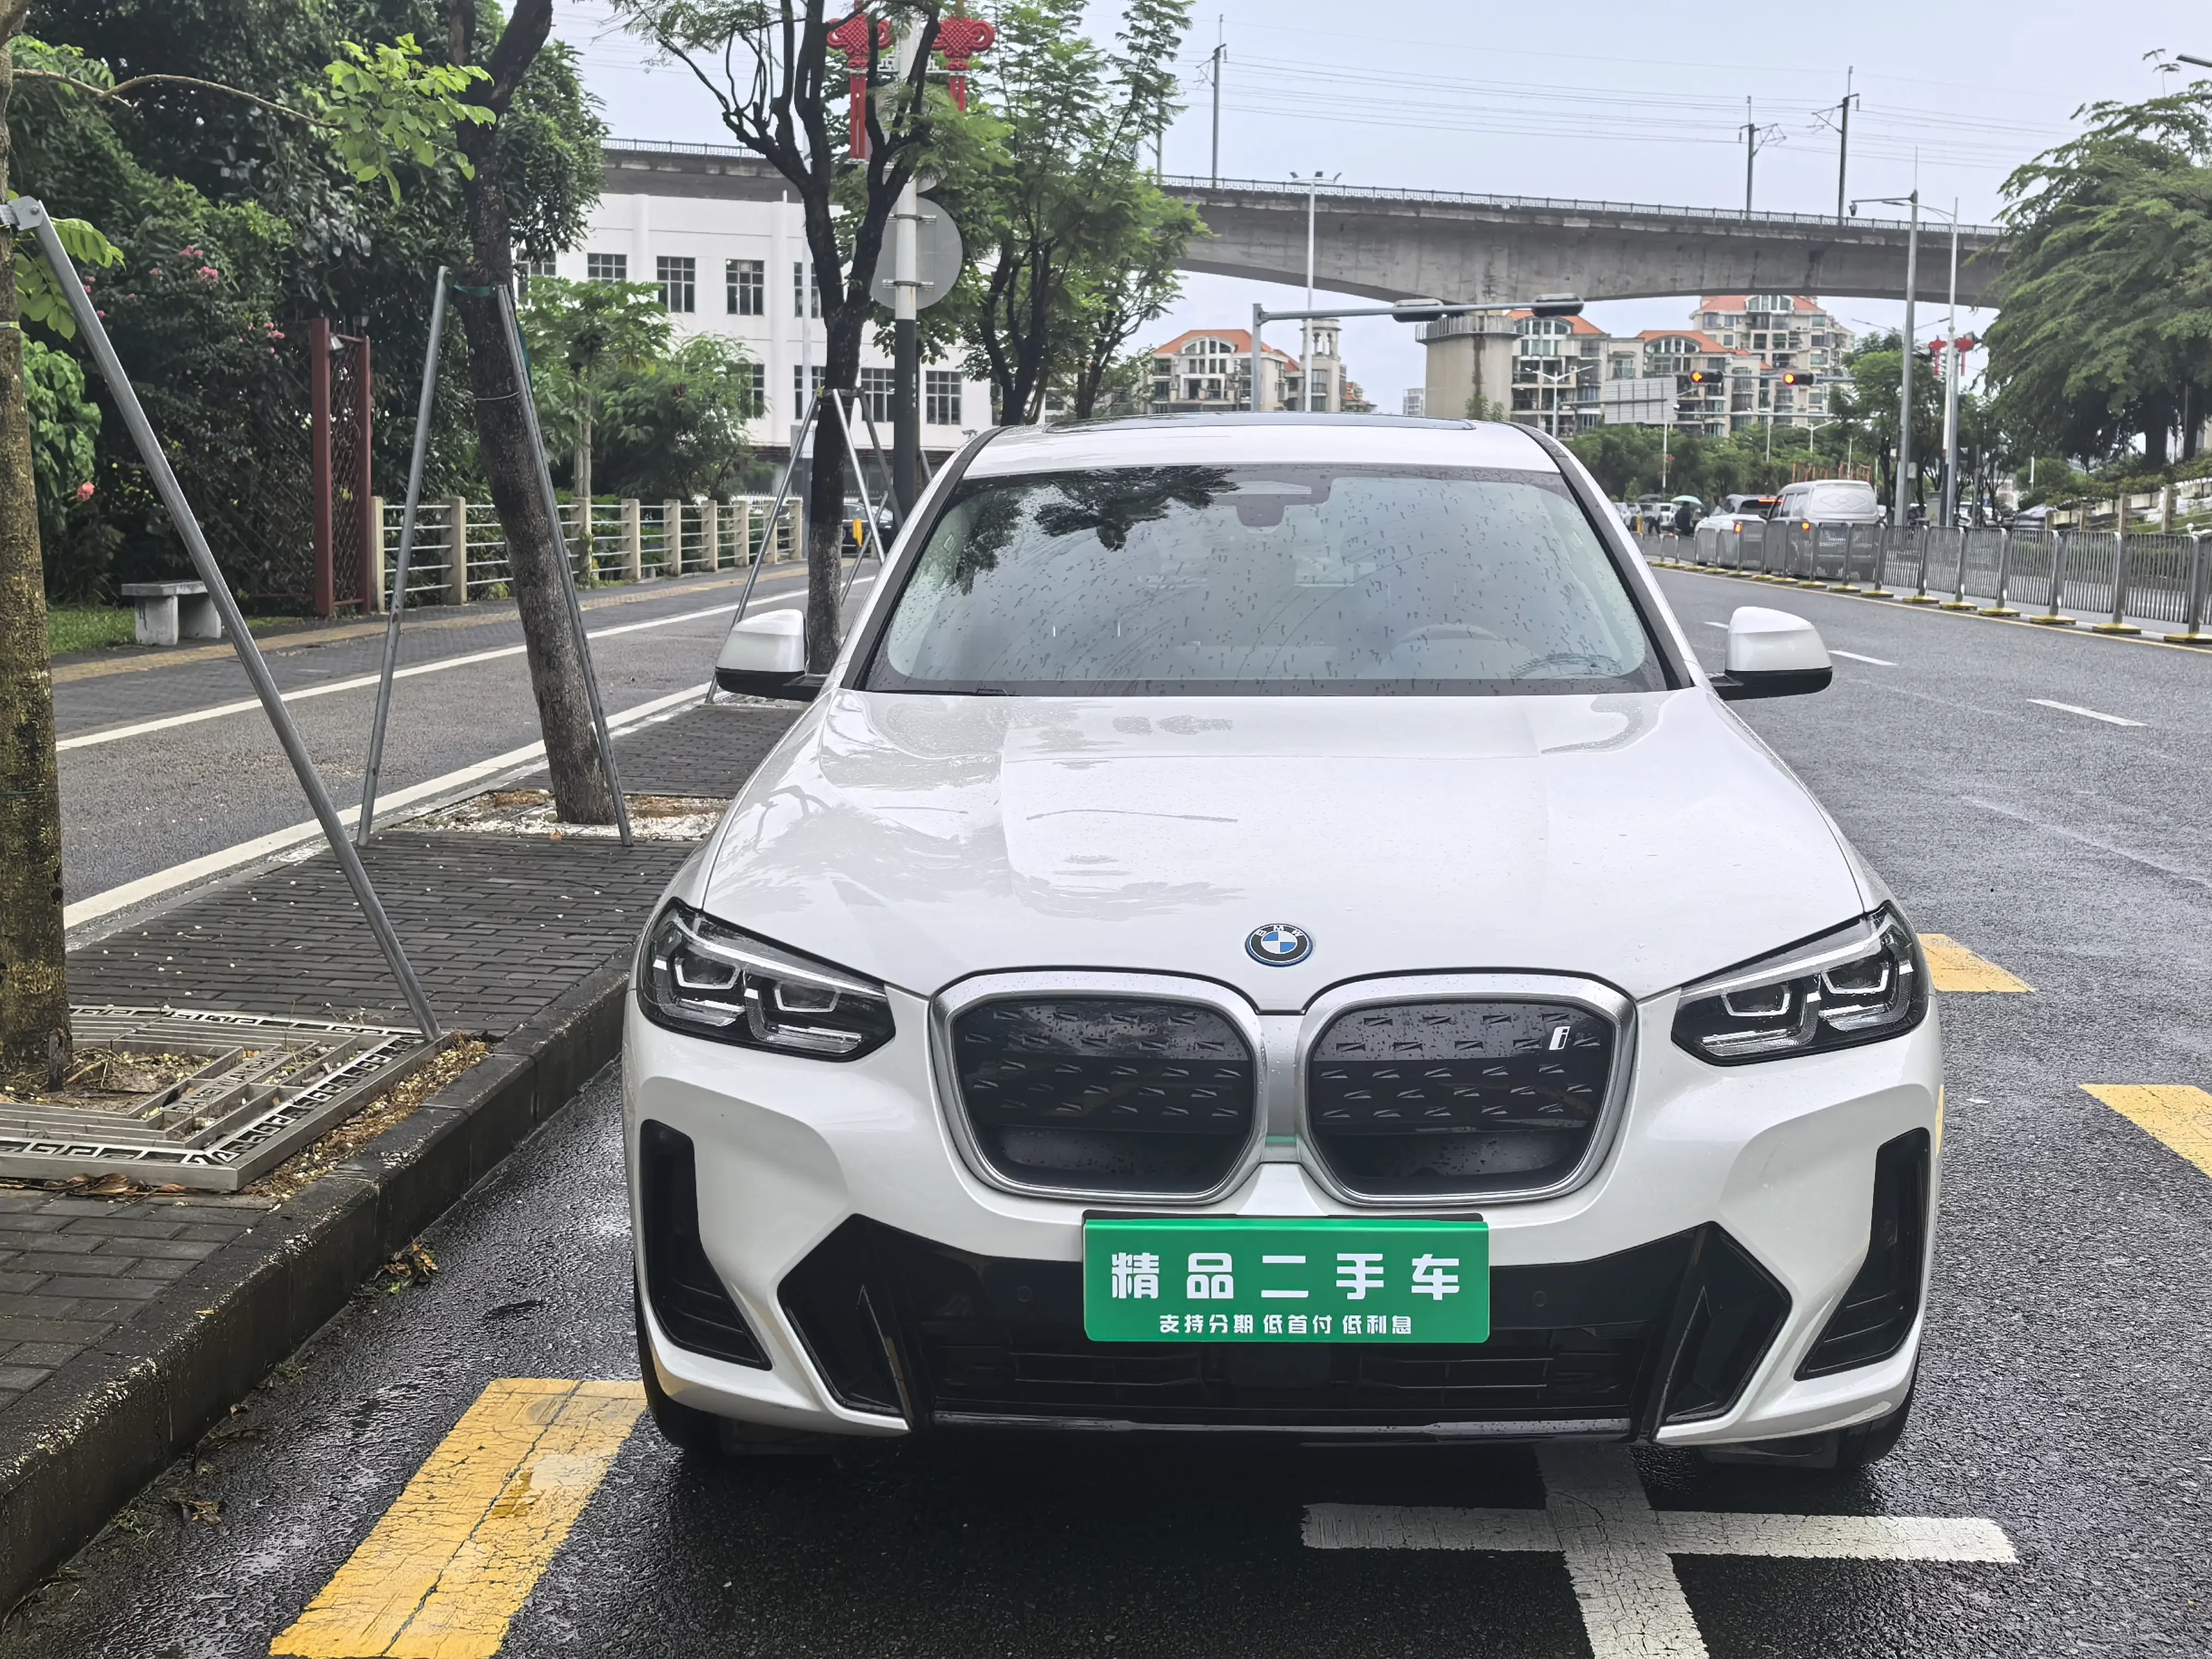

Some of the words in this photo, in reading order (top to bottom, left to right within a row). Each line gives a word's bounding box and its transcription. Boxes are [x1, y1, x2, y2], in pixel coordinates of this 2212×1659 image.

[1256, 925, 1303, 937] BMW
[1111, 1252, 1460, 1300] 精品二手车
[1160, 1314, 1253, 1333] 支持分期
[1263, 1314, 1332, 1334] 低首付
[1343, 1315, 1411, 1334] 低利息
